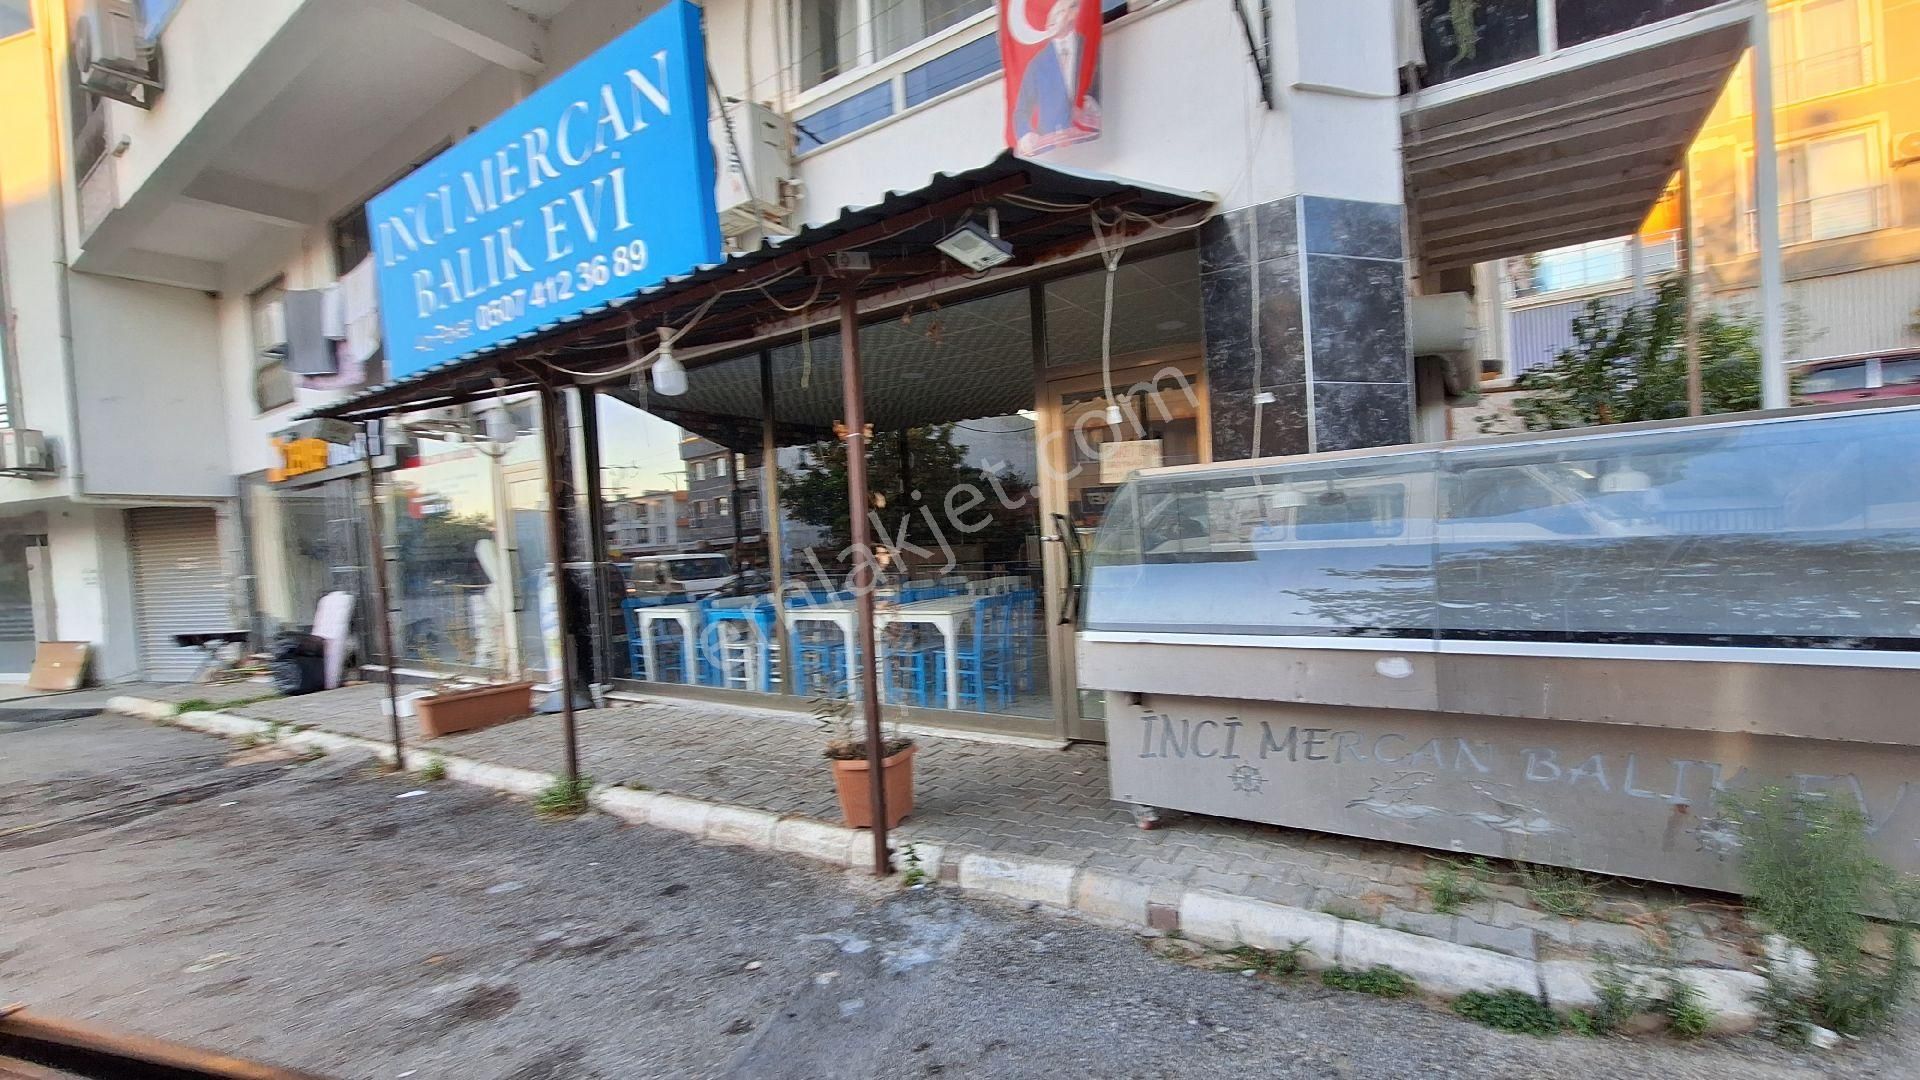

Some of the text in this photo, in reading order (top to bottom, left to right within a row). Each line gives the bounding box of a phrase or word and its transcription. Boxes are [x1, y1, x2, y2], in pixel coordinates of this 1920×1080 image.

[461, 49, 672, 223] MERCAN
[412, 151, 634, 318] BALIK EVİ
[529, 270, 576, 308] 412
[575, 255, 610, 292] 36
[612, 239, 648, 277] 89
[1138, 709, 1243, 760] İNCİ
[1259, 720, 1494, 774] MERCAN
